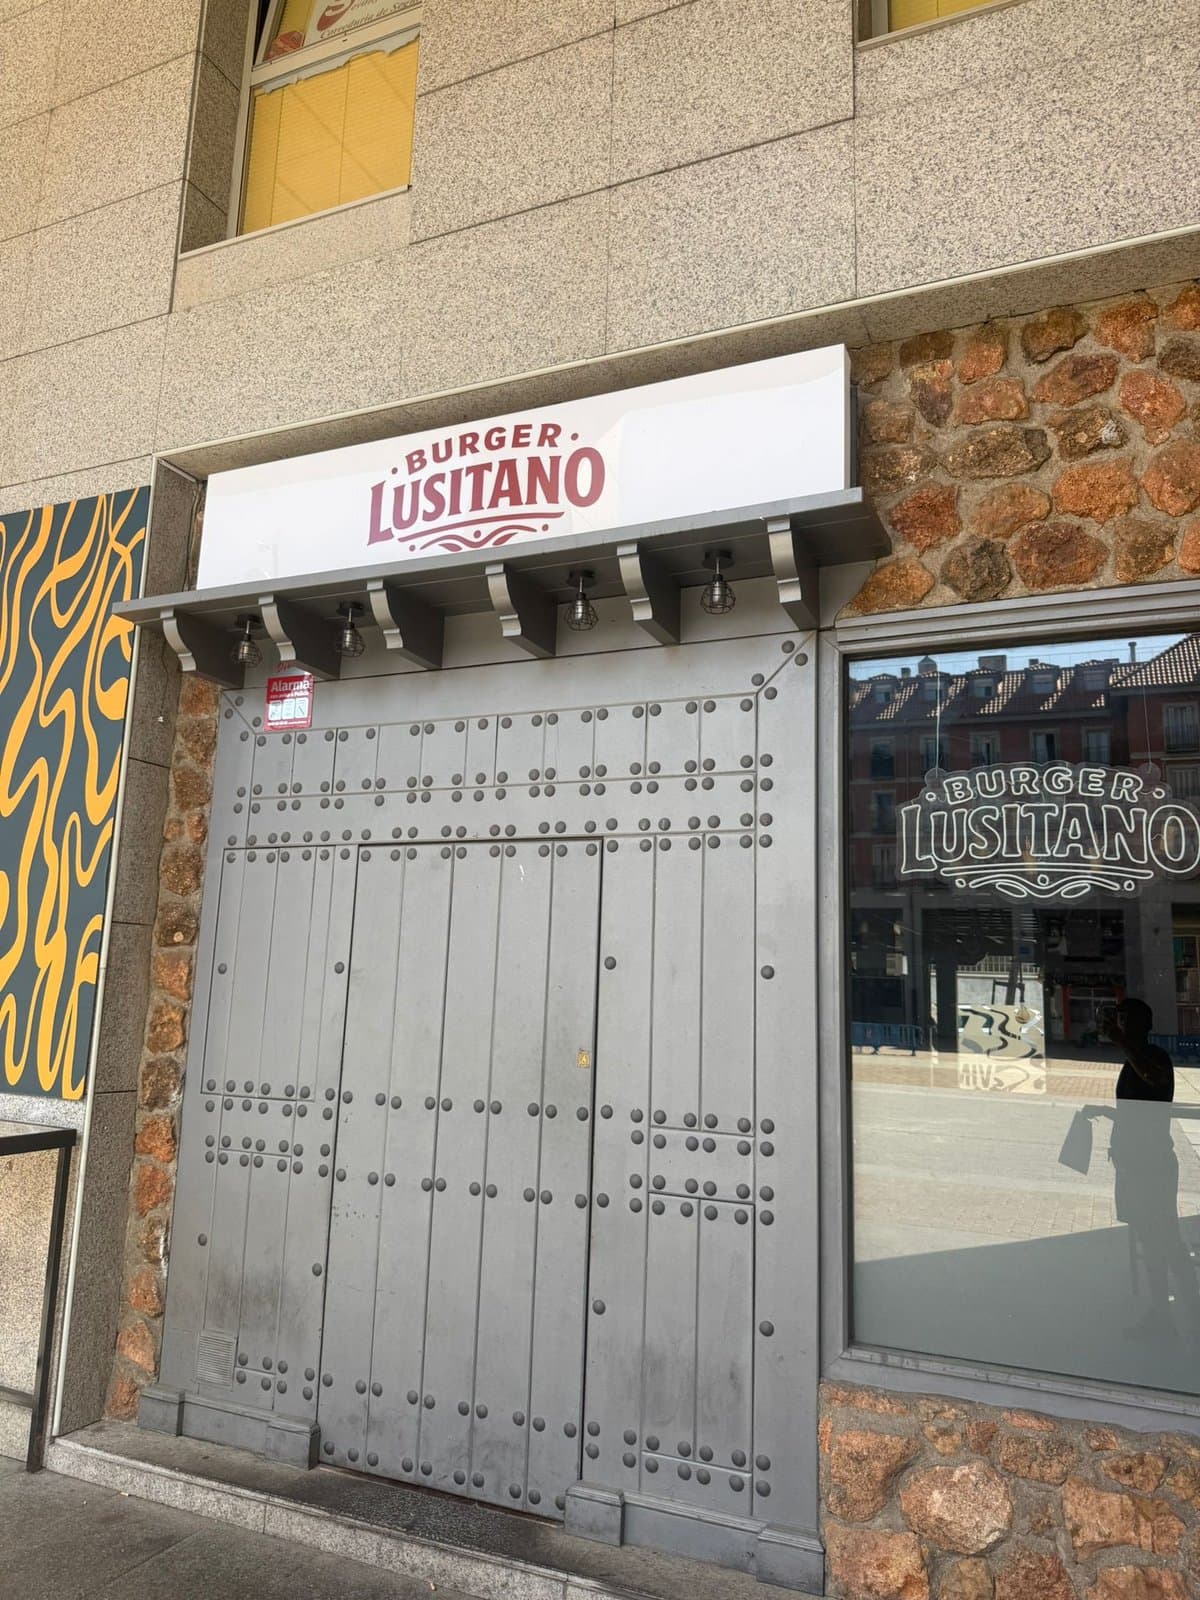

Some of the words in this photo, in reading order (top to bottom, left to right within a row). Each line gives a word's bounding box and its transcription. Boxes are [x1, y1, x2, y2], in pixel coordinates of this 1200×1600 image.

[405, 423, 562, 475] BURGER
[367, 447, 605, 546] LUSITANO
[271, 679, 310, 692] Alarma
[943, 767, 1143, 804] BURGER
[900, 804, 1200, 874] LUSITANO
